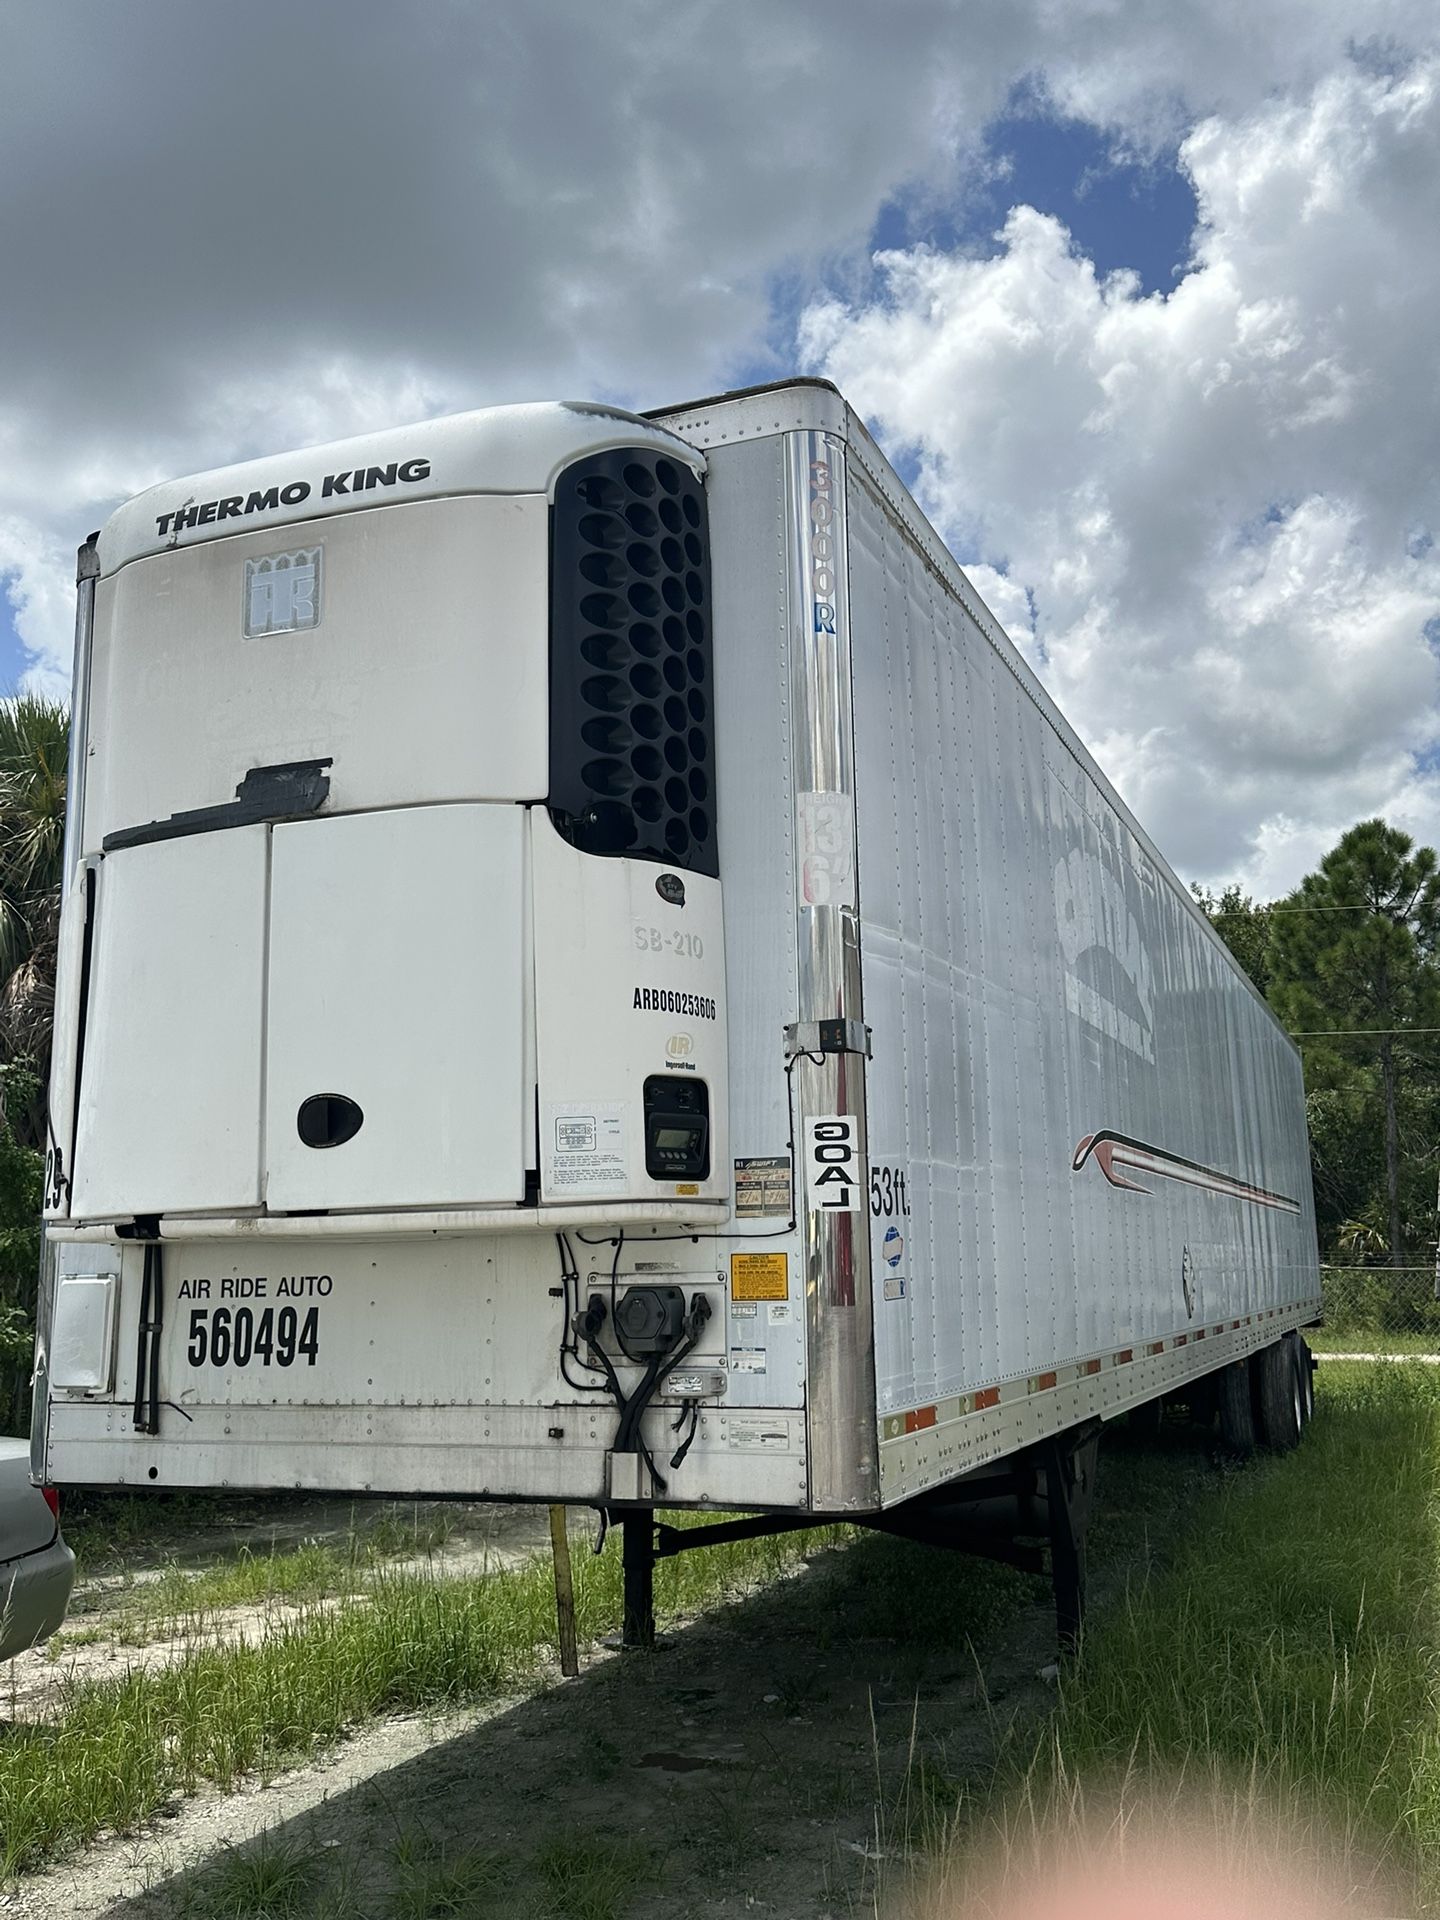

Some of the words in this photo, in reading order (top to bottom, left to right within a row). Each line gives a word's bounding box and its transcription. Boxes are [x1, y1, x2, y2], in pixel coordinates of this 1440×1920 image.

[156, 482, 311, 536] THERMO
[321, 459, 431, 498] KING
[633, 987, 716, 1021] ARB060253606
[177, 1279, 212, 1300] AIR
[220, 1277, 268, 1299] RIDE
[276, 1274, 333, 1298] AUTO
[187, 1306, 320, 1368] 560494
